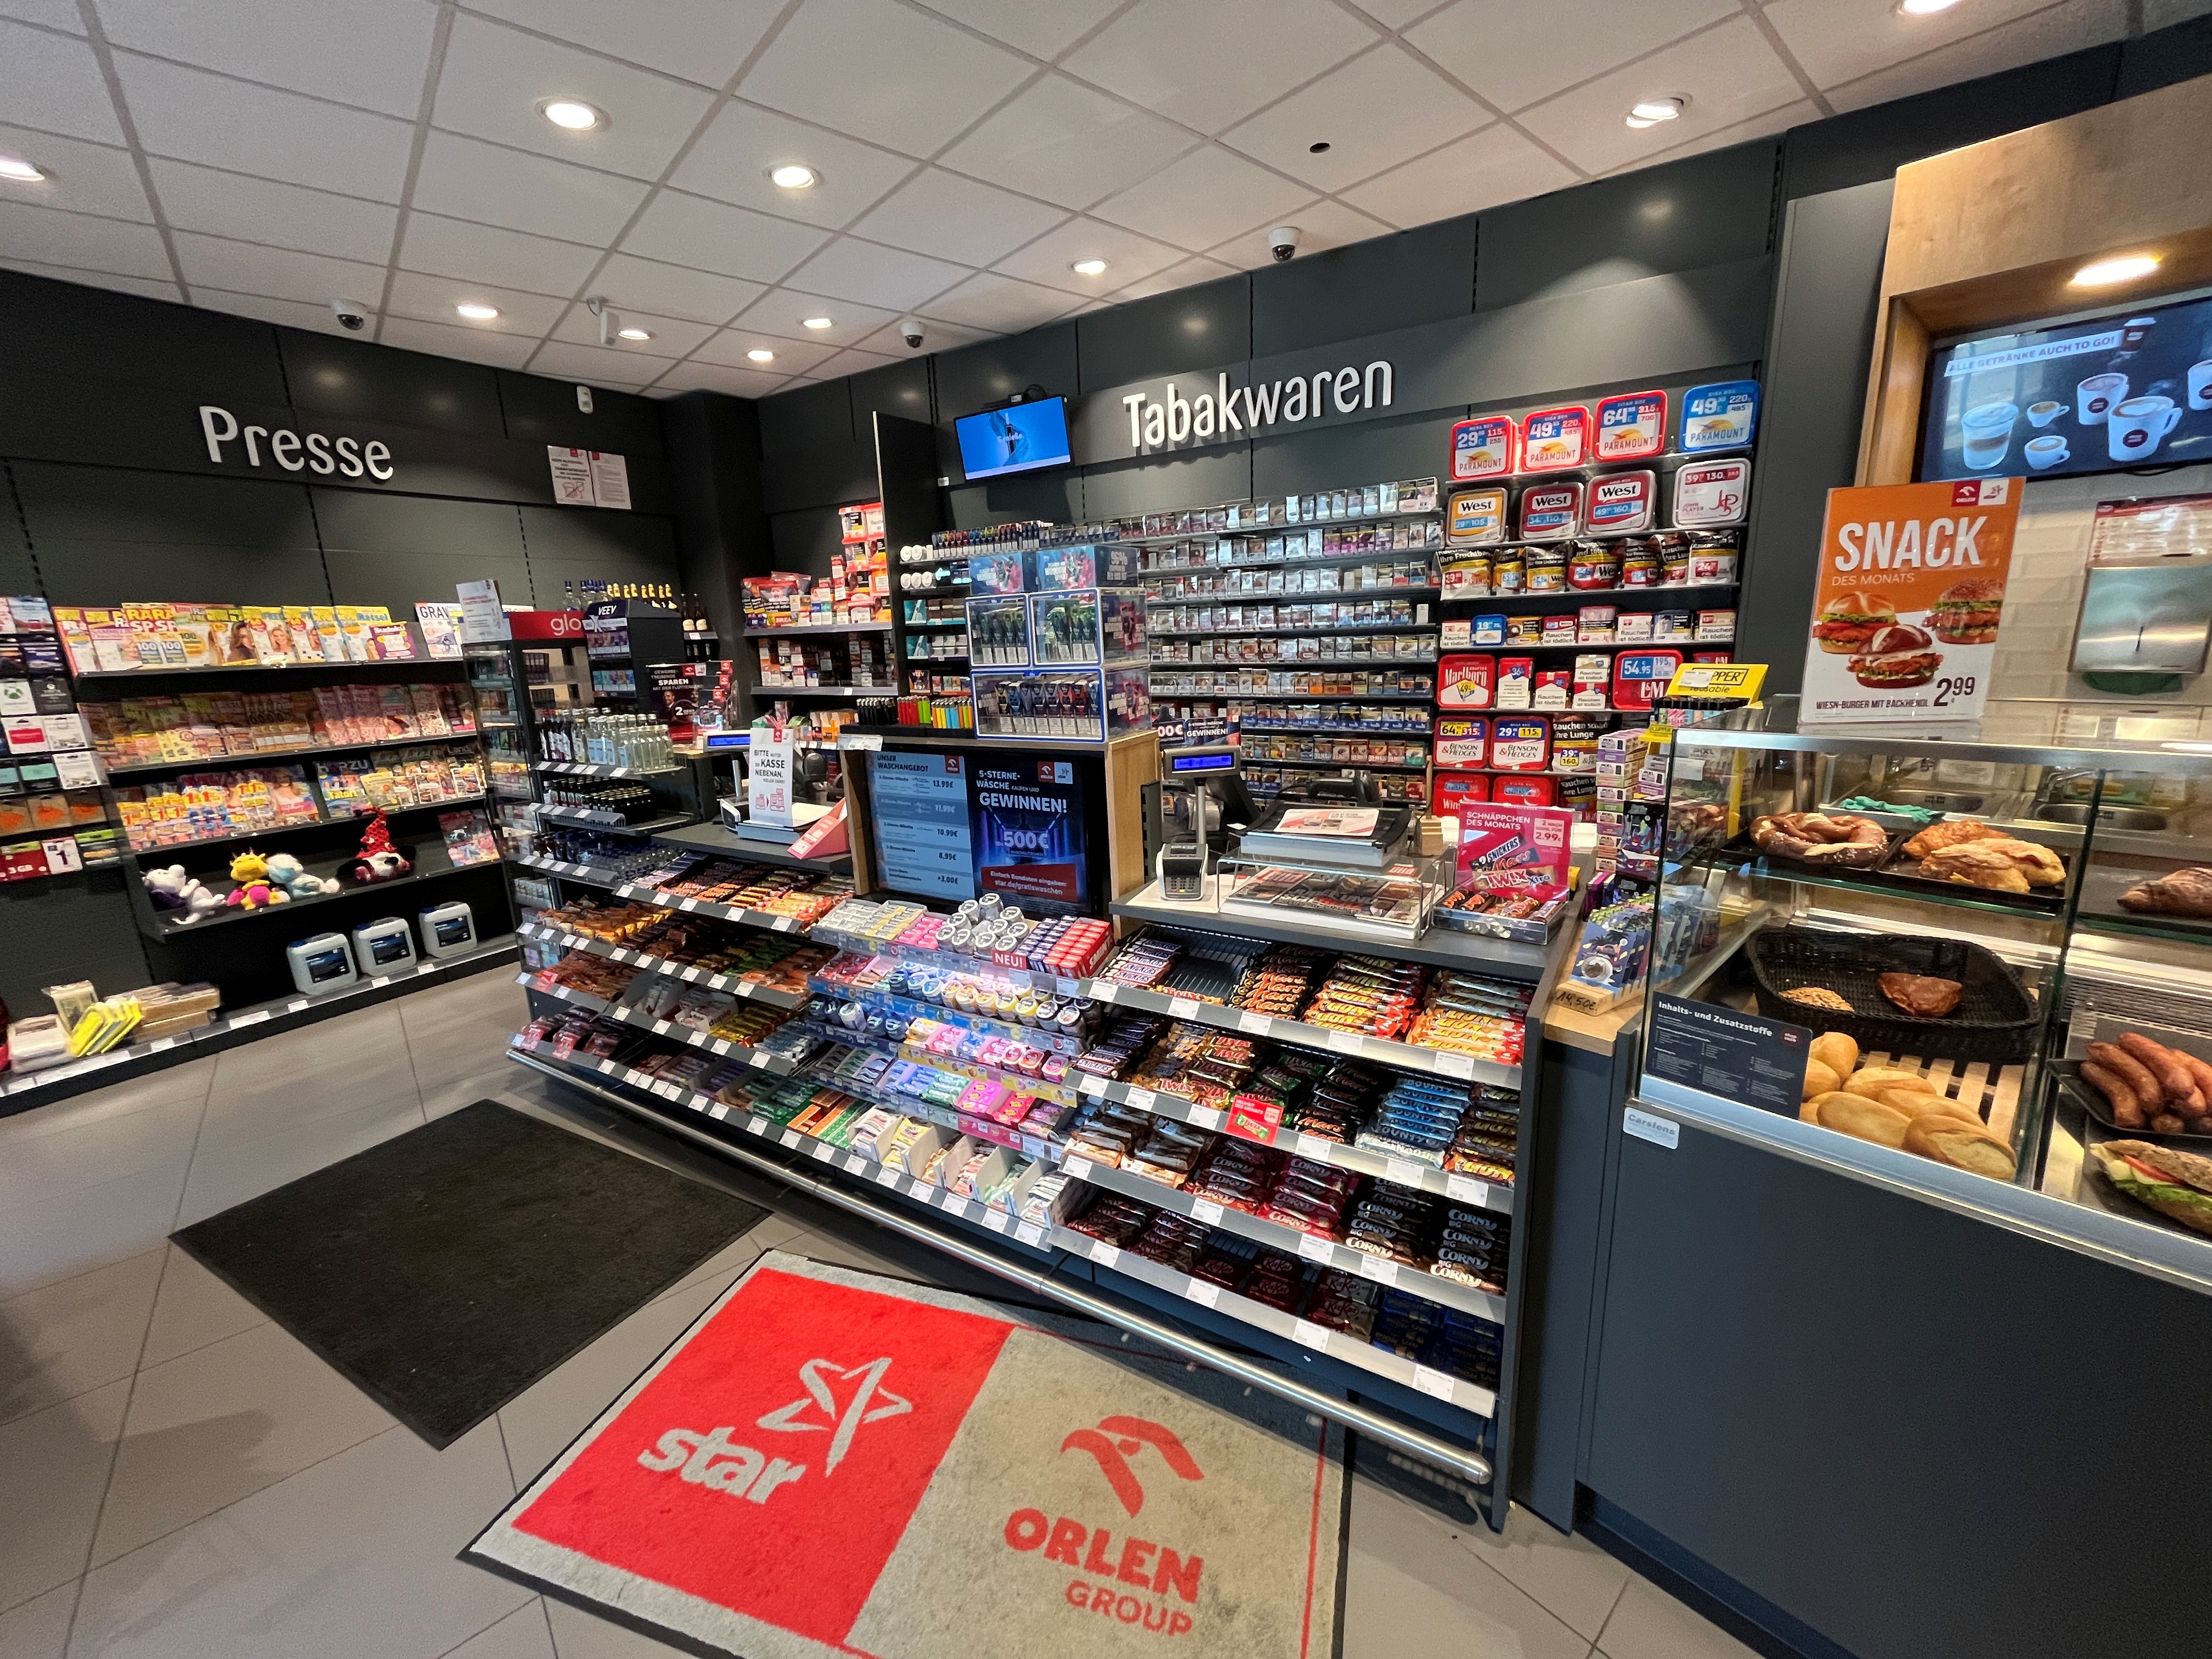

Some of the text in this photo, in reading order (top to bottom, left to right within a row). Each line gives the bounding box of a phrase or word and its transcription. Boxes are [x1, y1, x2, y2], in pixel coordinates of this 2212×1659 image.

[1949, 336, 2115, 372] ALLE GETRÄNKE AUCH TO GO!
[1122, 360, 1392, 447] Tabakwaren
[1690, 428, 1743, 442] PARAMOUNT
[199, 405, 394, 481] Presse
[1604, 437, 1654, 451] PARAMOUNT
[1530, 450, 1576, 462] PARAMOUNT
[1459, 458, 1502, 472] PARAMOUNT
[1602, 484, 1637, 497] West
[1462, 500, 1491, 511] West
[1536, 495, 1567, 506] West
[1835, 516, 1988, 572] SNACK
[1832, 572, 1915, 586] DES MONATS
[598, 605, 617, 616] VEEV
[550, 614, 582, 636] glo
[1445, 666, 1487, 686] Marlboro
[1640, 681, 1664, 701] L&M
[675, 707, 683, 716] 2
[1816, 699, 1929, 709] WIESN-BURGER MIT BACKHENDL
[1187, 728, 1228, 737] GEWINNEN!
[1553, 722, 1586, 730] Rauchen
[1570, 731, 1594, 740] Lunge
[1449, 749, 1476, 757] HEDGES
[761, 759, 785, 769] KASSE
[877, 763, 929, 772] WASCHANGEBOT
[755, 769, 783, 778] NEBENAN.
[979, 770, 1020, 780] 5-STERNE-
[977, 778, 1009, 790] WÄSCHE
[979, 792, 1068, 813] GEWINNEN!
[1466, 811, 1531, 824] SCHNÄPPCHEN
[1466, 818, 1521, 831] DES MONATS
[1488, 837, 1520, 862] SNICKERS
[57, 850, 68, 865] 1
[1493, 850, 1531, 871] Mars
[990, 870, 1010, 879] Einfach
[995, 880, 1063, 895] star.de/gratiswaschen
[995, 952, 1023, 967] NEU!
[1115, 970, 1154, 983] SNICKERS
[1124, 963, 1161, 975] SNICKERS
[1240, 997, 1295, 1013] Mars
[1556, 991, 1596, 1011] 14,50€
[1658, 1001, 1773, 1037] Inhalts- und Zusatzstoffe
[1077, 1059, 1111, 1071] SNICKERS
[1159, 1078, 1195, 1093] TWIX
[1407, 1079, 1453, 1093] BOUNTY
[1212, 1156, 1254, 1173] CORNY
[1291, 1158, 1330, 1177] CORNY
[1275, 1193, 1316, 1211] CORNY
[1358, 1200, 1403, 1220] CORNY
[1268, 1211, 1312, 1231] CORNY
[1448, 1209, 1497, 1231] CORNY
[1351, 1218, 1397, 1238] CORNY
[1442, 1228, 1492, 1250] CORNY
[1346, 1237, 1393, 1259] CORNY
[1264, 1259, 1291, 1272] KitKat
[1438, 1248, 1489, 1270] CORNY
[1207, 1262, 1233, 1274] KitKat
[1430, 1263, 1482, 1288] CORNY
[1260, 1280, 1289, 1295] KitKat
[1328, 1276, 1358, 1293] KitKat
[1325, 1300, 1357, 1317] KitKat
[638, 1425, 808, 1505] star
[1005, 1508, 1204, 1604] ORLEN
[1066, 1579, 1194, 1637] GROUP
